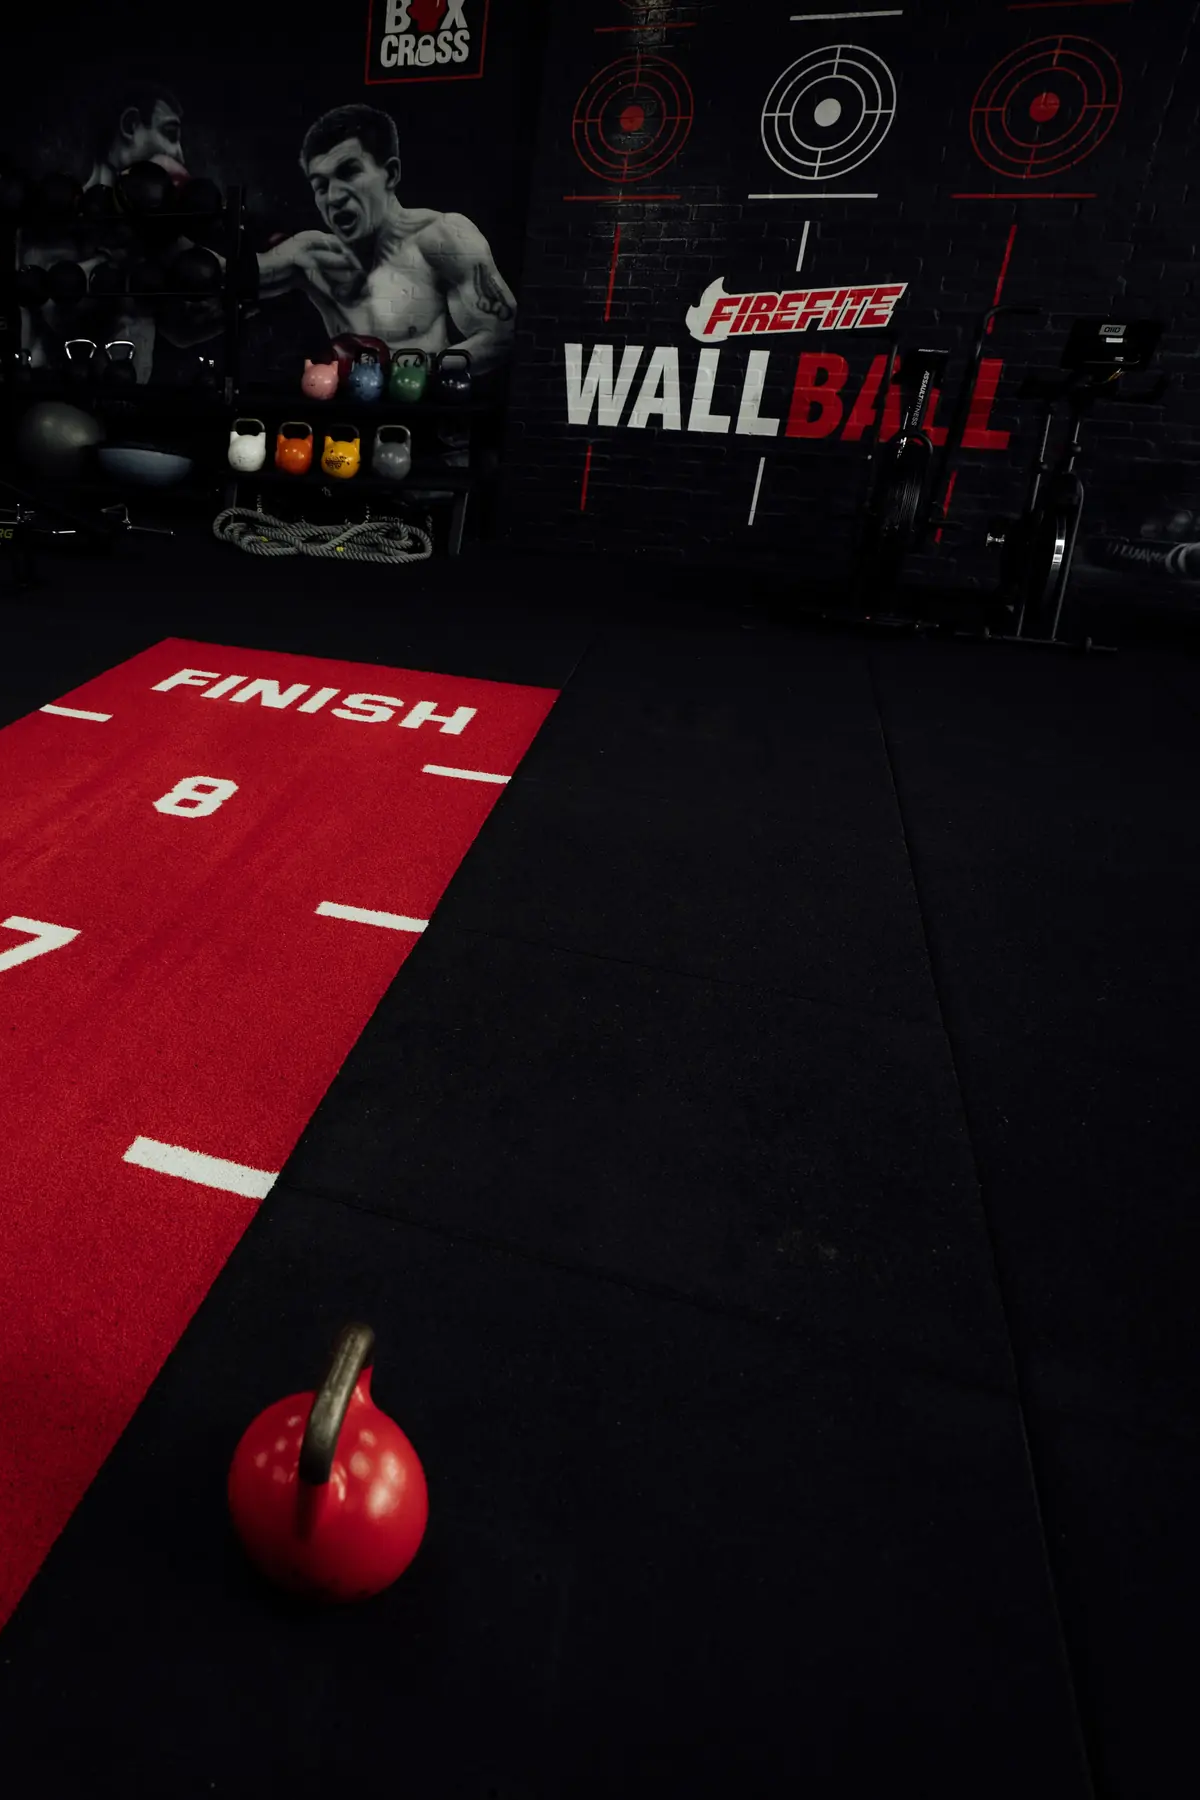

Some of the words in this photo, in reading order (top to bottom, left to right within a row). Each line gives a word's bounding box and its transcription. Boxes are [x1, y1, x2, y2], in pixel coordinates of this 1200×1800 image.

[380, 29, 471, 68] CROSS
[702, 283, 906, 335] FIREFITE
[564, 342, 780, 437] WALL
[150, 668, 478, 735] FINISH
[152, 775, 240, 818] 8
